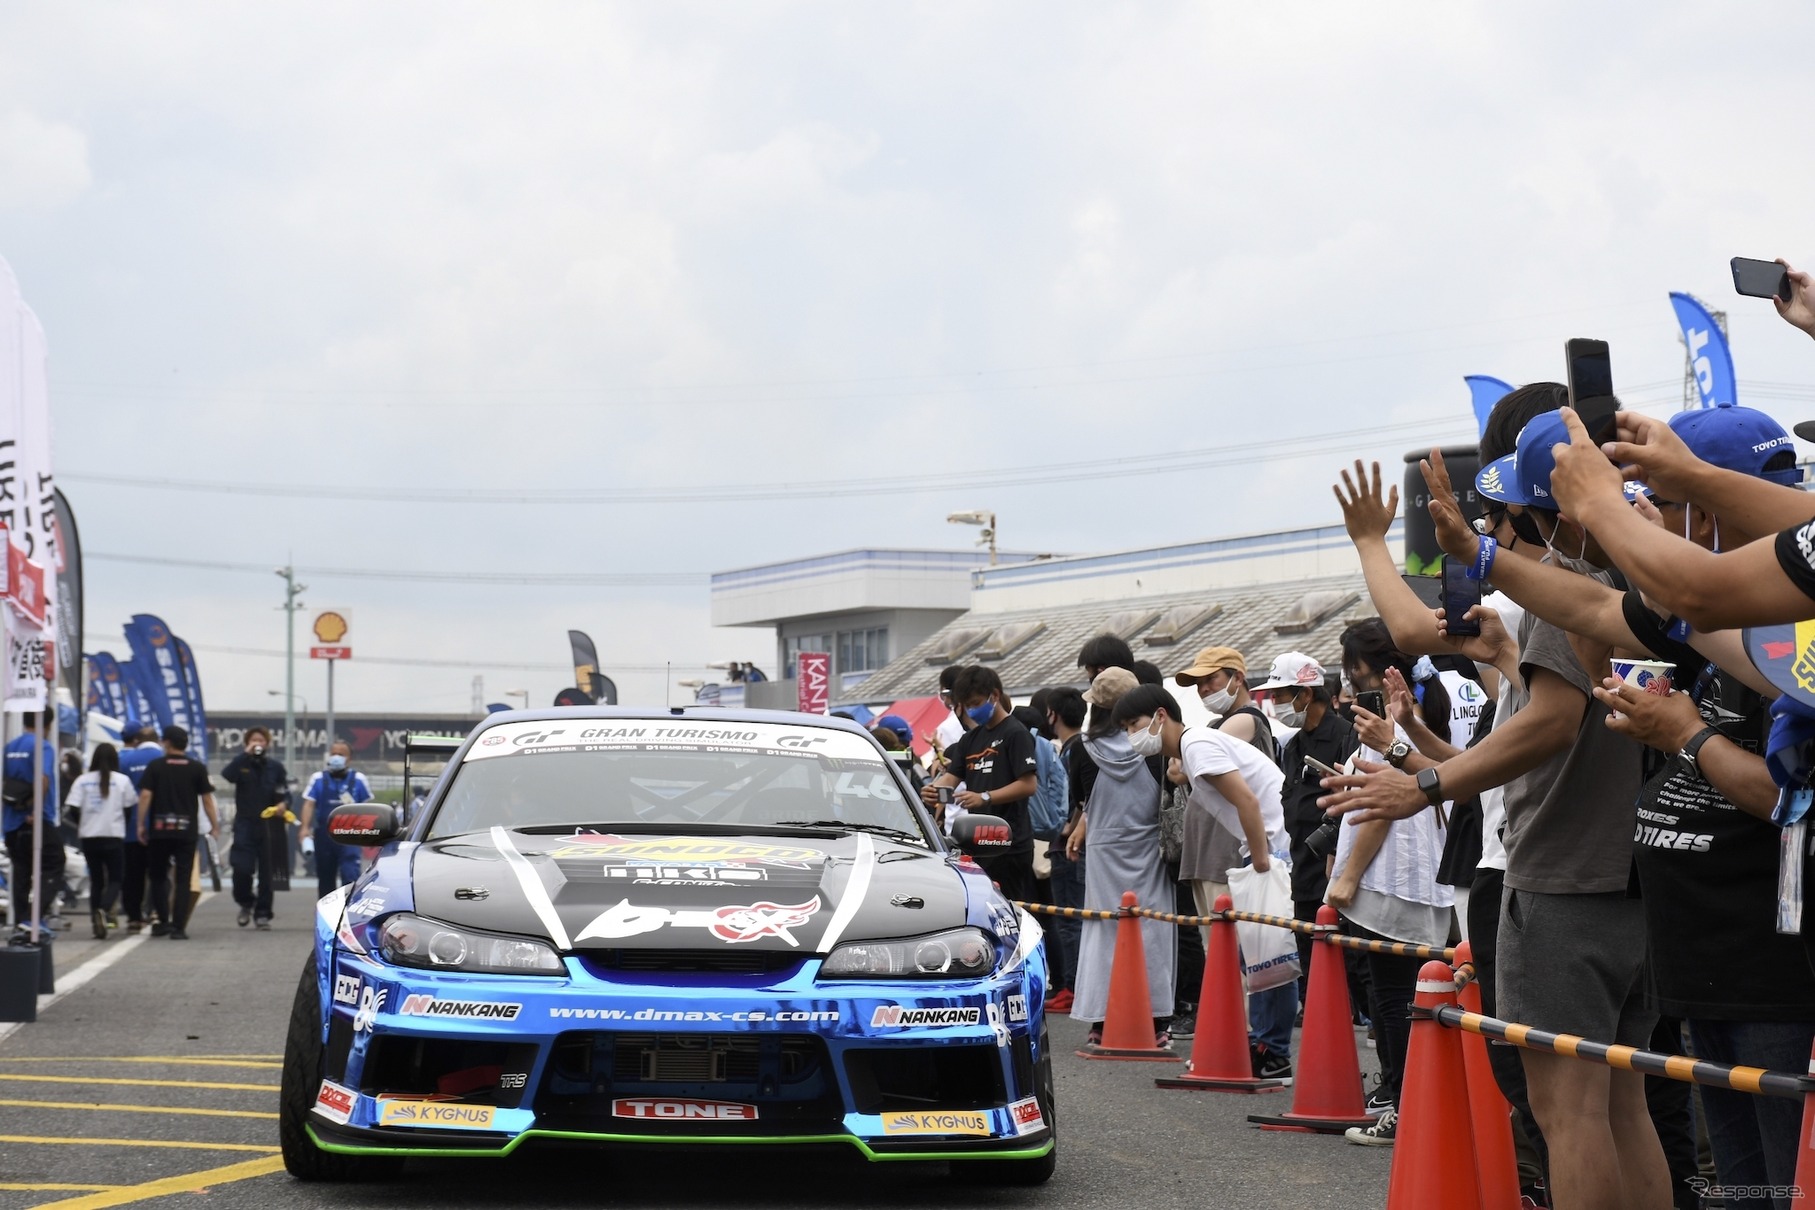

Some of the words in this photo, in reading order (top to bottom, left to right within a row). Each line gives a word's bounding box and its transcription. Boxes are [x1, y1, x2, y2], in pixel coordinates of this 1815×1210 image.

[1752, 439, 1777, 453] TOYO
[580, 728, 647, 738] GRAN
[655, 728, 758, 741] TURISMO
[834, 772, 900, 802] 46
[1247, 961, 1272, 974] TOYO
[427, 1001, 519, 1018] NANKANG
[550, 1008, 840, 1022] www.dmax-cs.com
[900, 1009, 978, 1024] NANKANG
[420, 1107, 489, 1123] KYGNUS
[626, 1101, 744, 1119] TONE
[922, 1115, 985, 1130] KYGNUS
